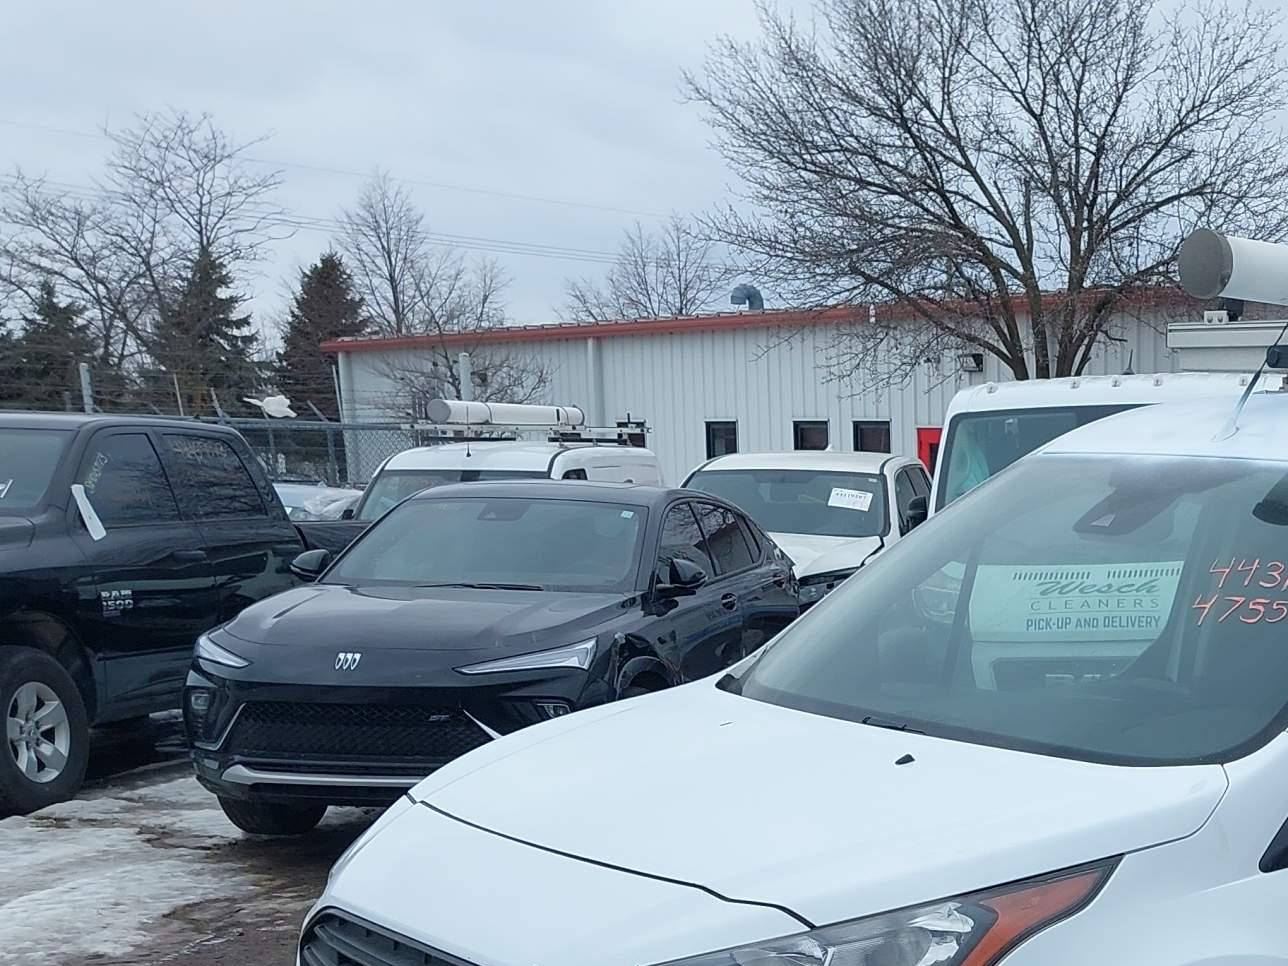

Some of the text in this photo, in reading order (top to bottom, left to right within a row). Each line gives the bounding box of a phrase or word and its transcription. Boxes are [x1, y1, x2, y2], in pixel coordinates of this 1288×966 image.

[1036, 577, 1160, 596] Wesch
[1030, 599, 1160, 611] CLEANERS
[1026, 616, 1161, 631] PICK-UP AND DELIVERY
